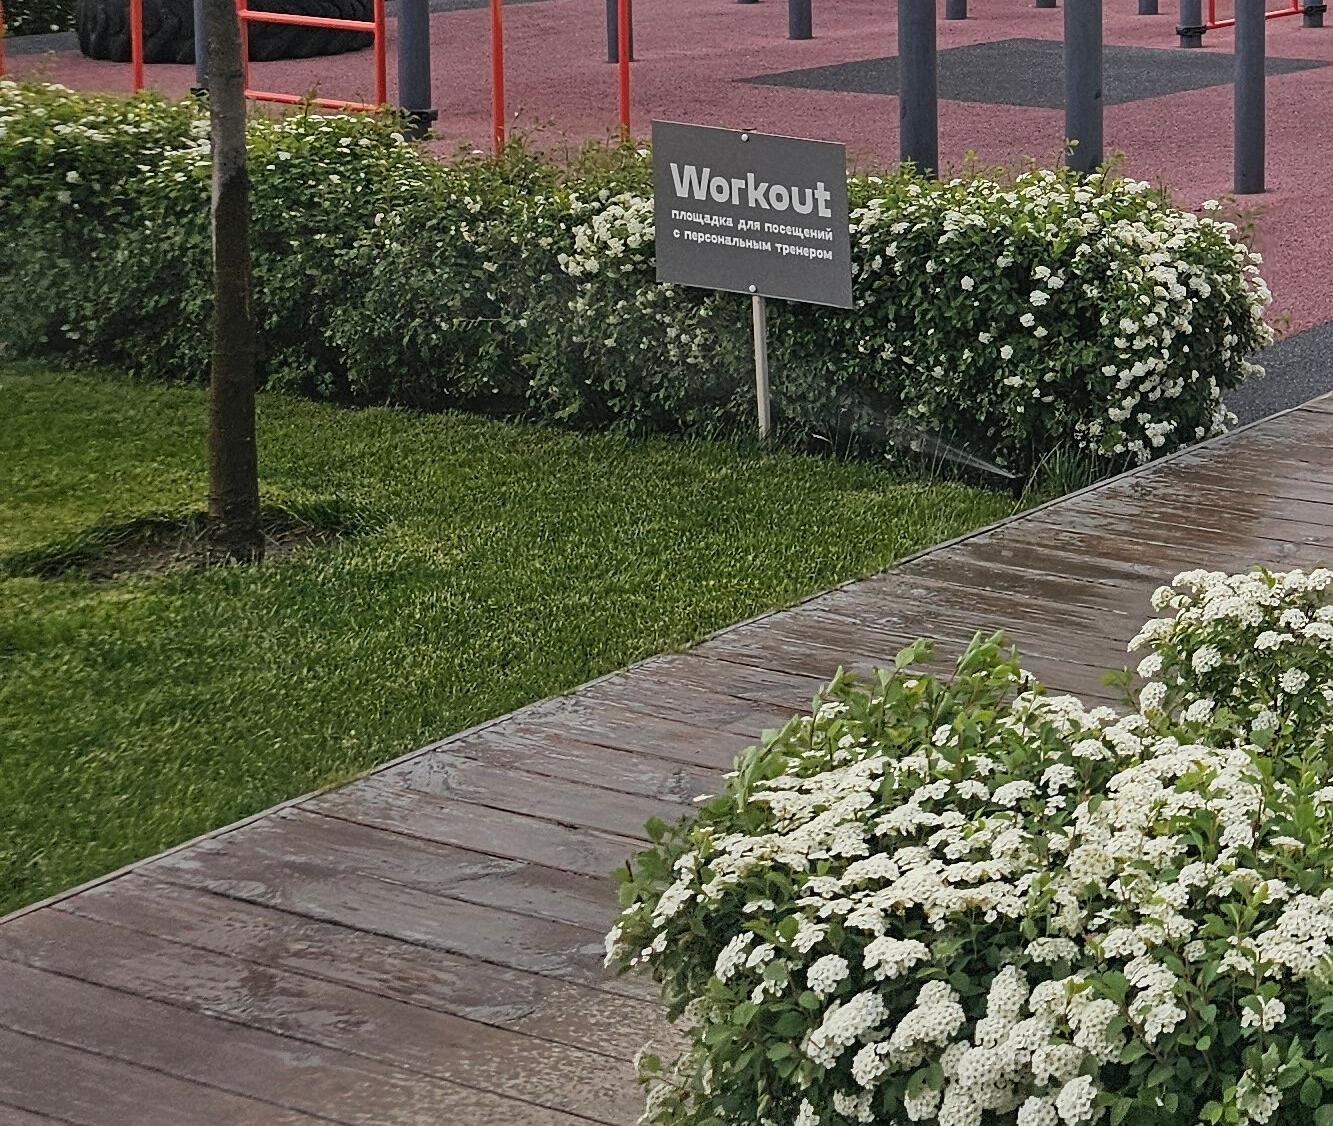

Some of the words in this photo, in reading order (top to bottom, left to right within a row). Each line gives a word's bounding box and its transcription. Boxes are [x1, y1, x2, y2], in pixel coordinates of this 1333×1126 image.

[669, 162, 832, 218] Workout
[671, 209, 734, 228] площадка
[737, 218, 761, 232] для
[764, 222, 833, 241] посещений
[672, 228, 681, 239] с
[684, 230, 772, 252] персональным
[775, 242, 833, 260] тренером
